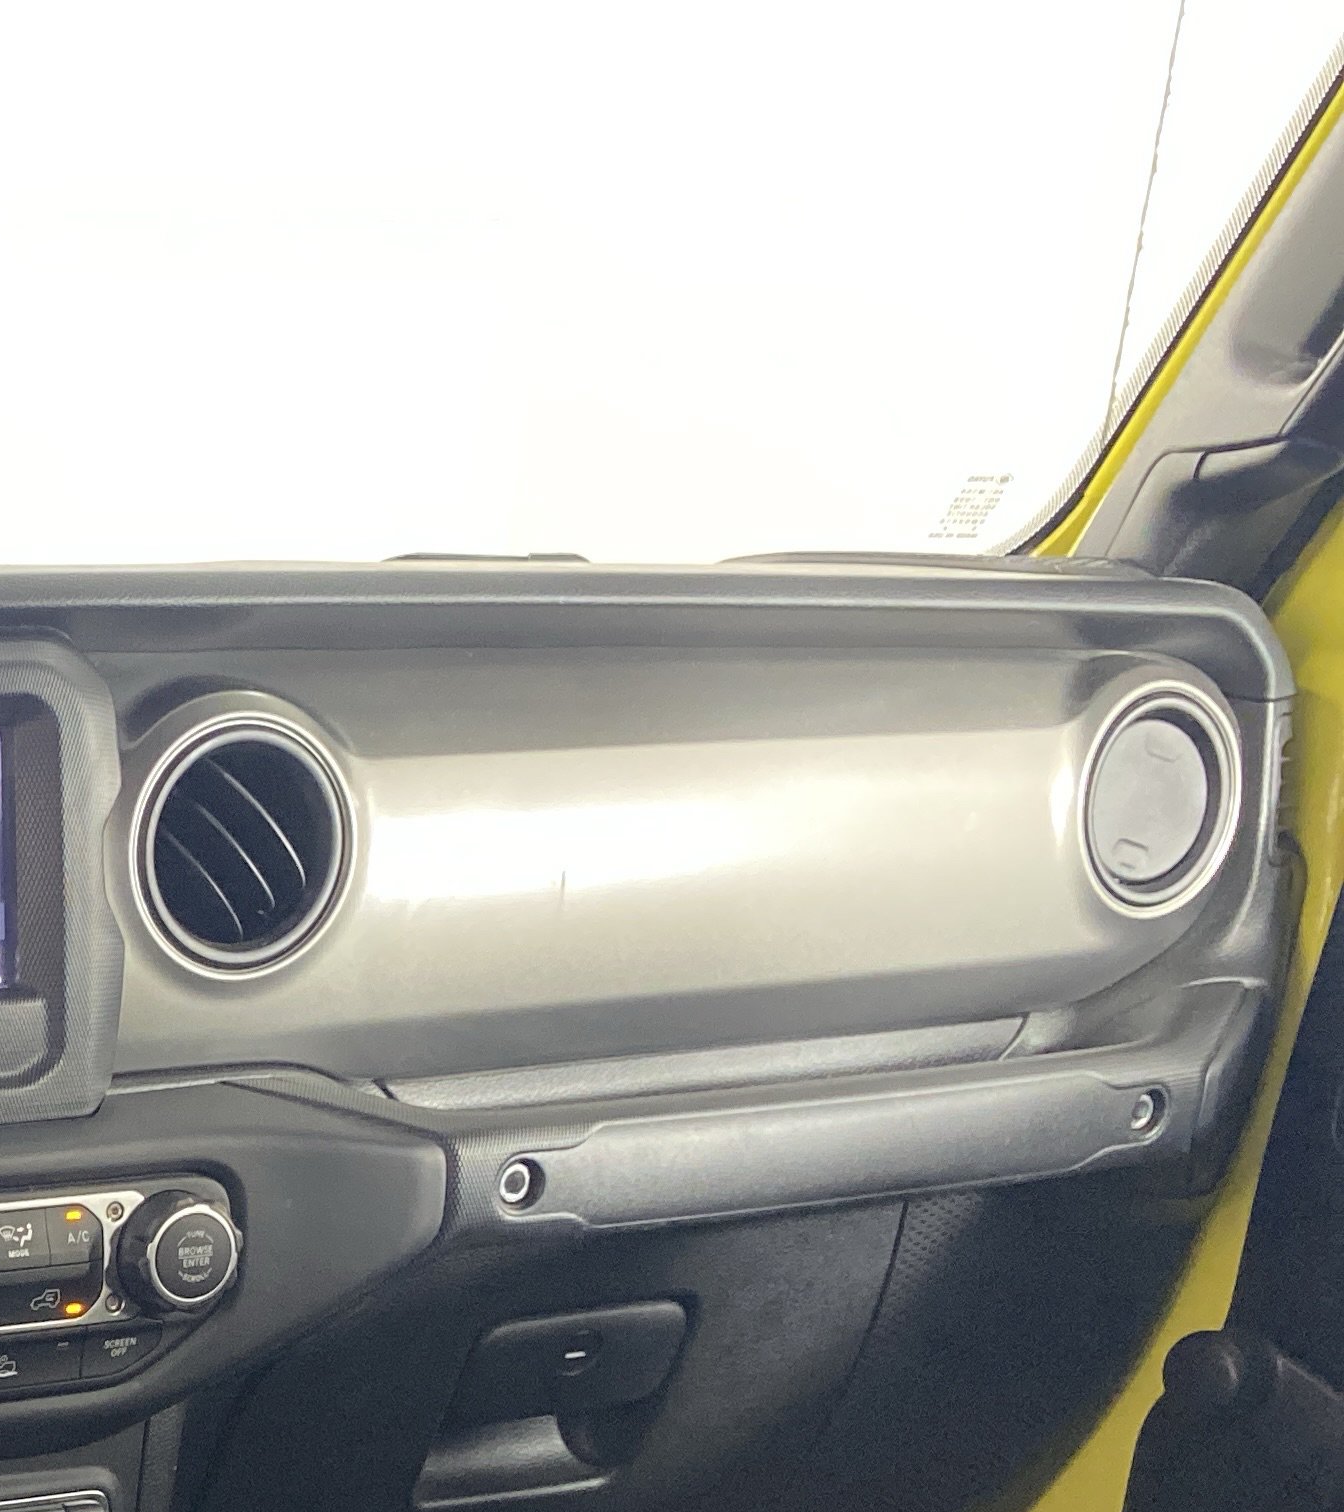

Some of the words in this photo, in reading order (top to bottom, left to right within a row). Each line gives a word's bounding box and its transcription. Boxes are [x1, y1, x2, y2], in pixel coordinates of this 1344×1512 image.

[67, 1230, 90, 1245] A/C
[8, 1248, 30, 1258] MODE
[178, 1244, 213, 1256] BROWSE
[183, 1257, 210, 1268] ENTER
[103, 1337, 137, 1350] SCREEN
[111, 1347, 128, 1357] OFF
